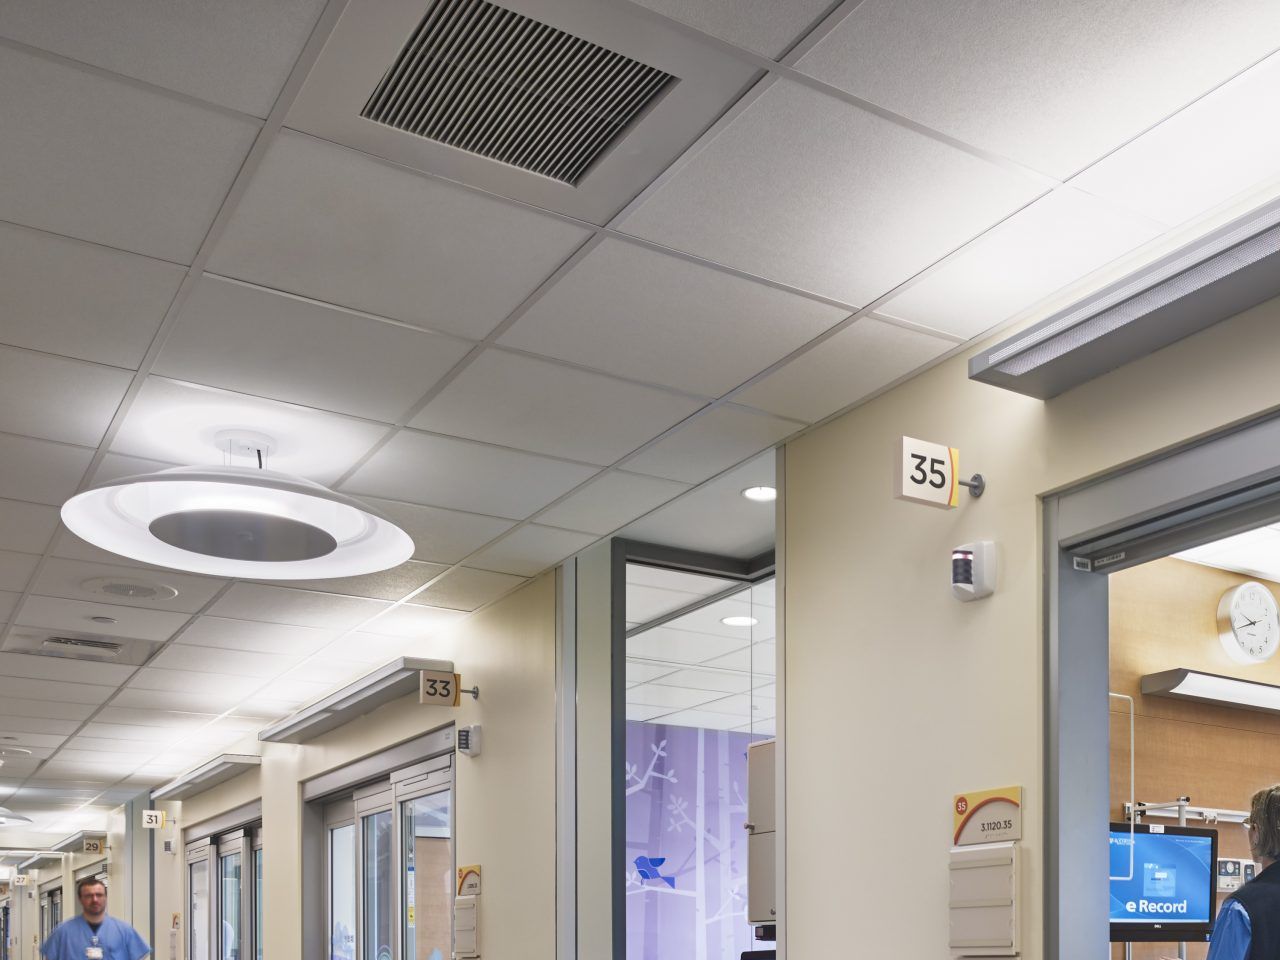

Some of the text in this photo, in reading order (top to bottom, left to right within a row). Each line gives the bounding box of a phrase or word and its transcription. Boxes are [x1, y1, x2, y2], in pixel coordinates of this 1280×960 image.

[910, 452, 946, 489] 35
[426, 678, 451, 698] 33
[957, 801, 967, 812] 35
[146, 814, 158, 825] 31
[981, 820, 1012, 832] 3.1120.35
[85, 842, 99, 851] 29
[16, 876, 26, 884] 27
[1125, 899, 1187, 914] e Record
